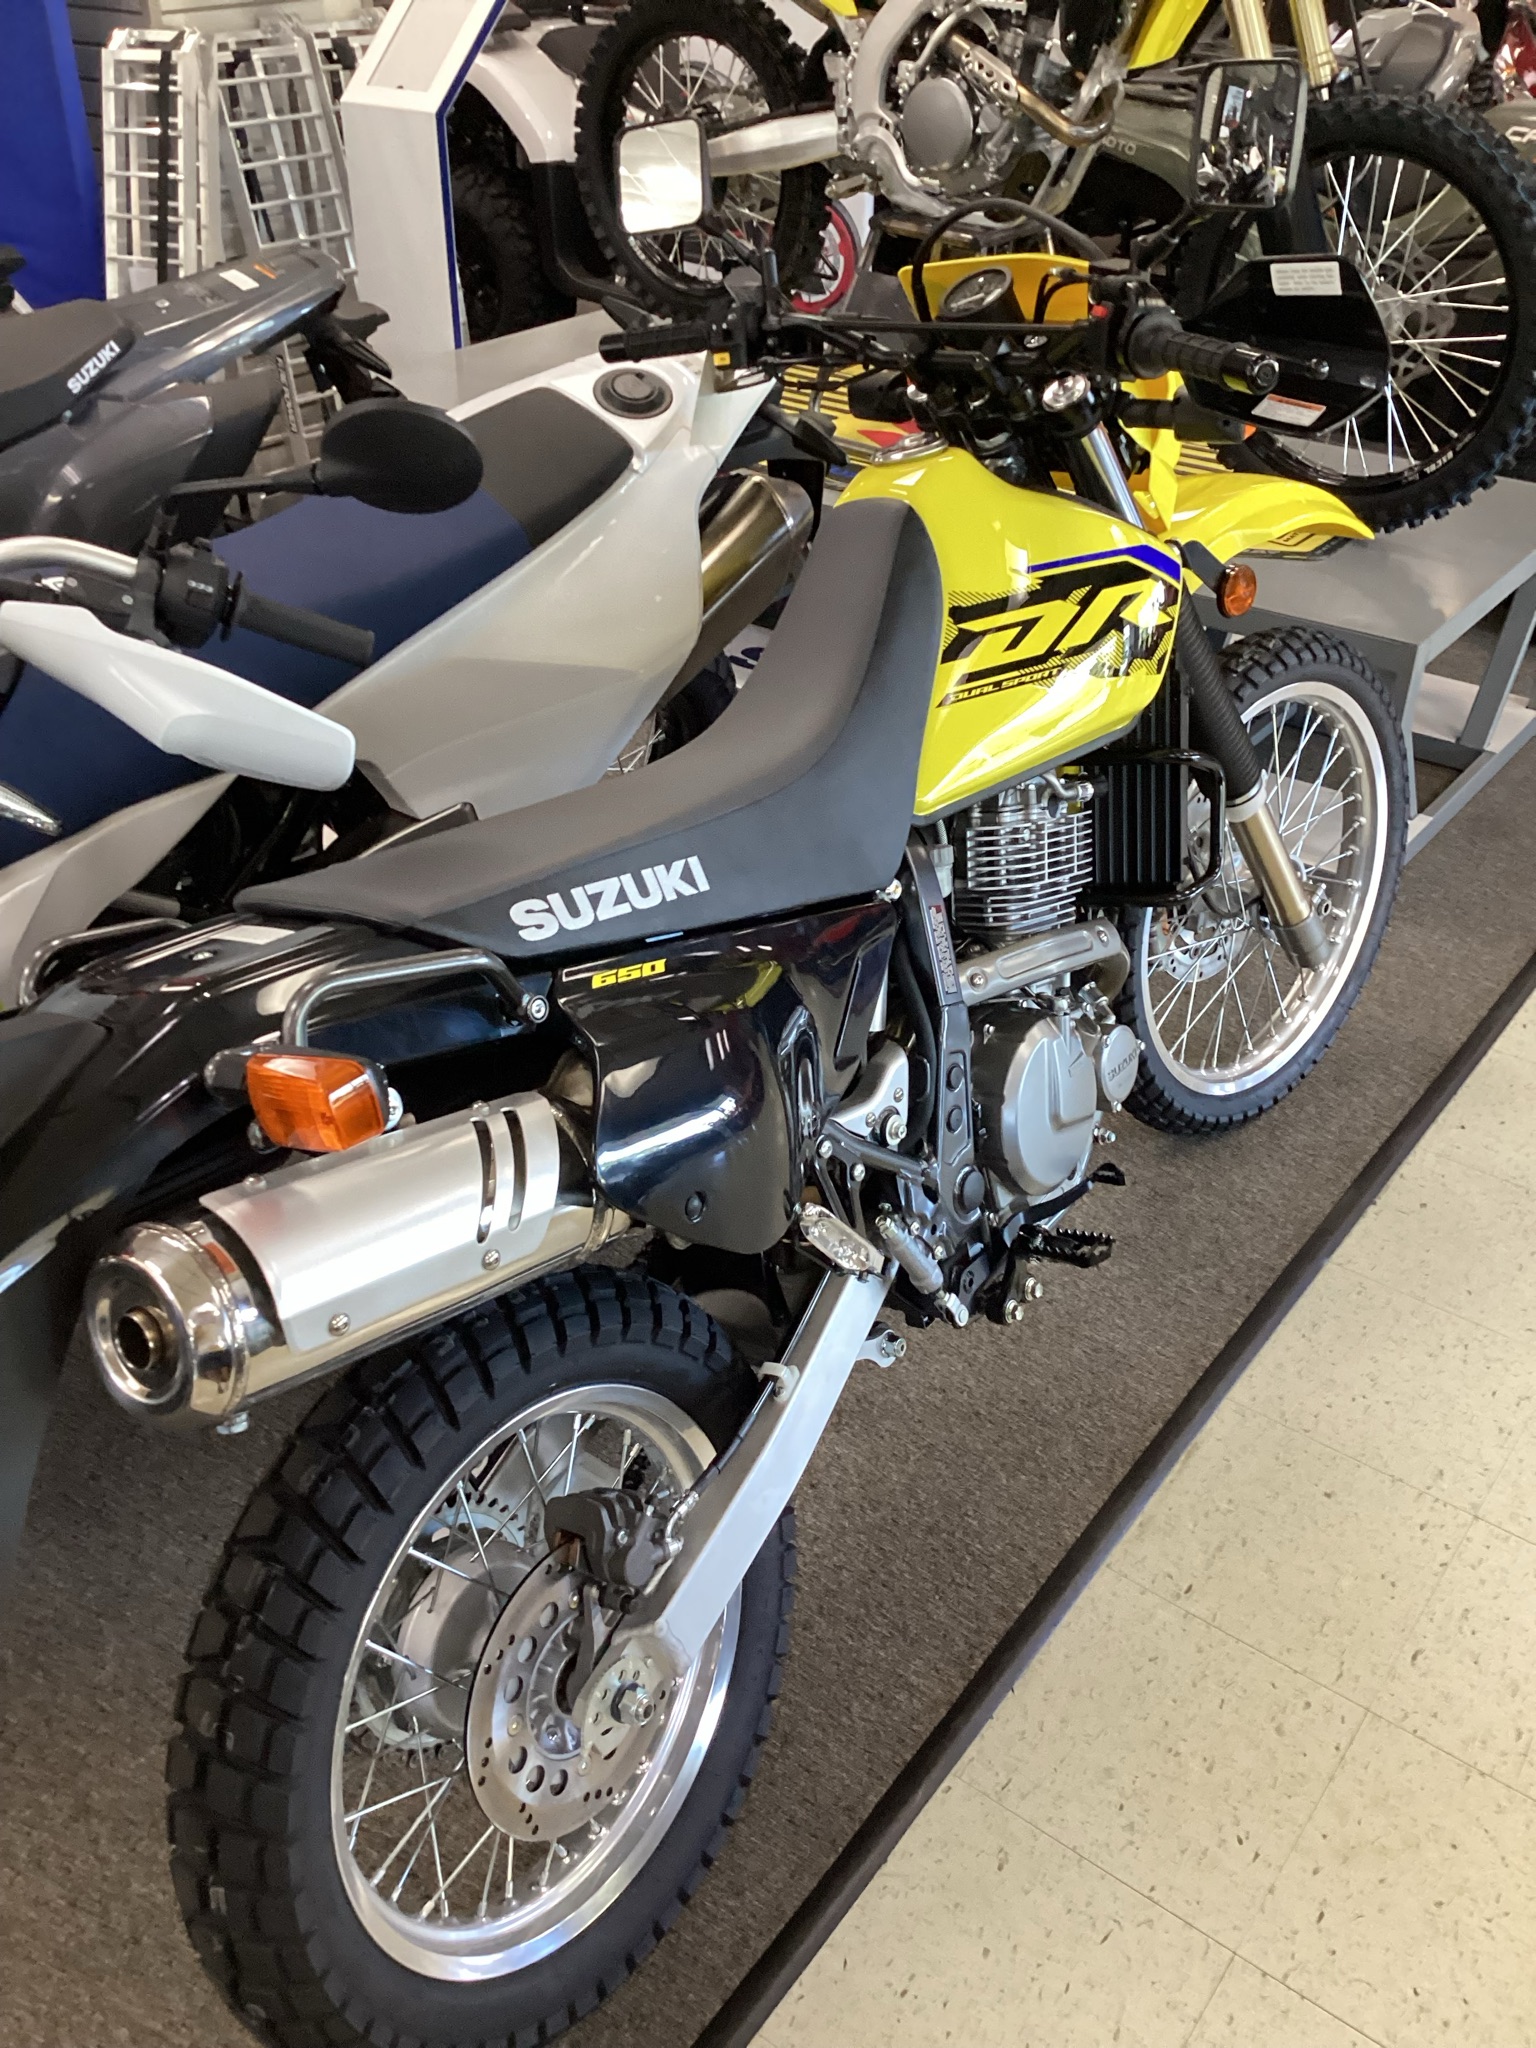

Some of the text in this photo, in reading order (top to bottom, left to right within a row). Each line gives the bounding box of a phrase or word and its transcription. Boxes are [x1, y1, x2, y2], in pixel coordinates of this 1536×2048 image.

[67, 340, 120, 394] SUZUKI
[957, 577, 1173, 675] DR
[949, 667, 1062, 703] DUAL SPORT
[509, 855, 711, 942] SUZUKI
[591, 958, 667, 990] 650
